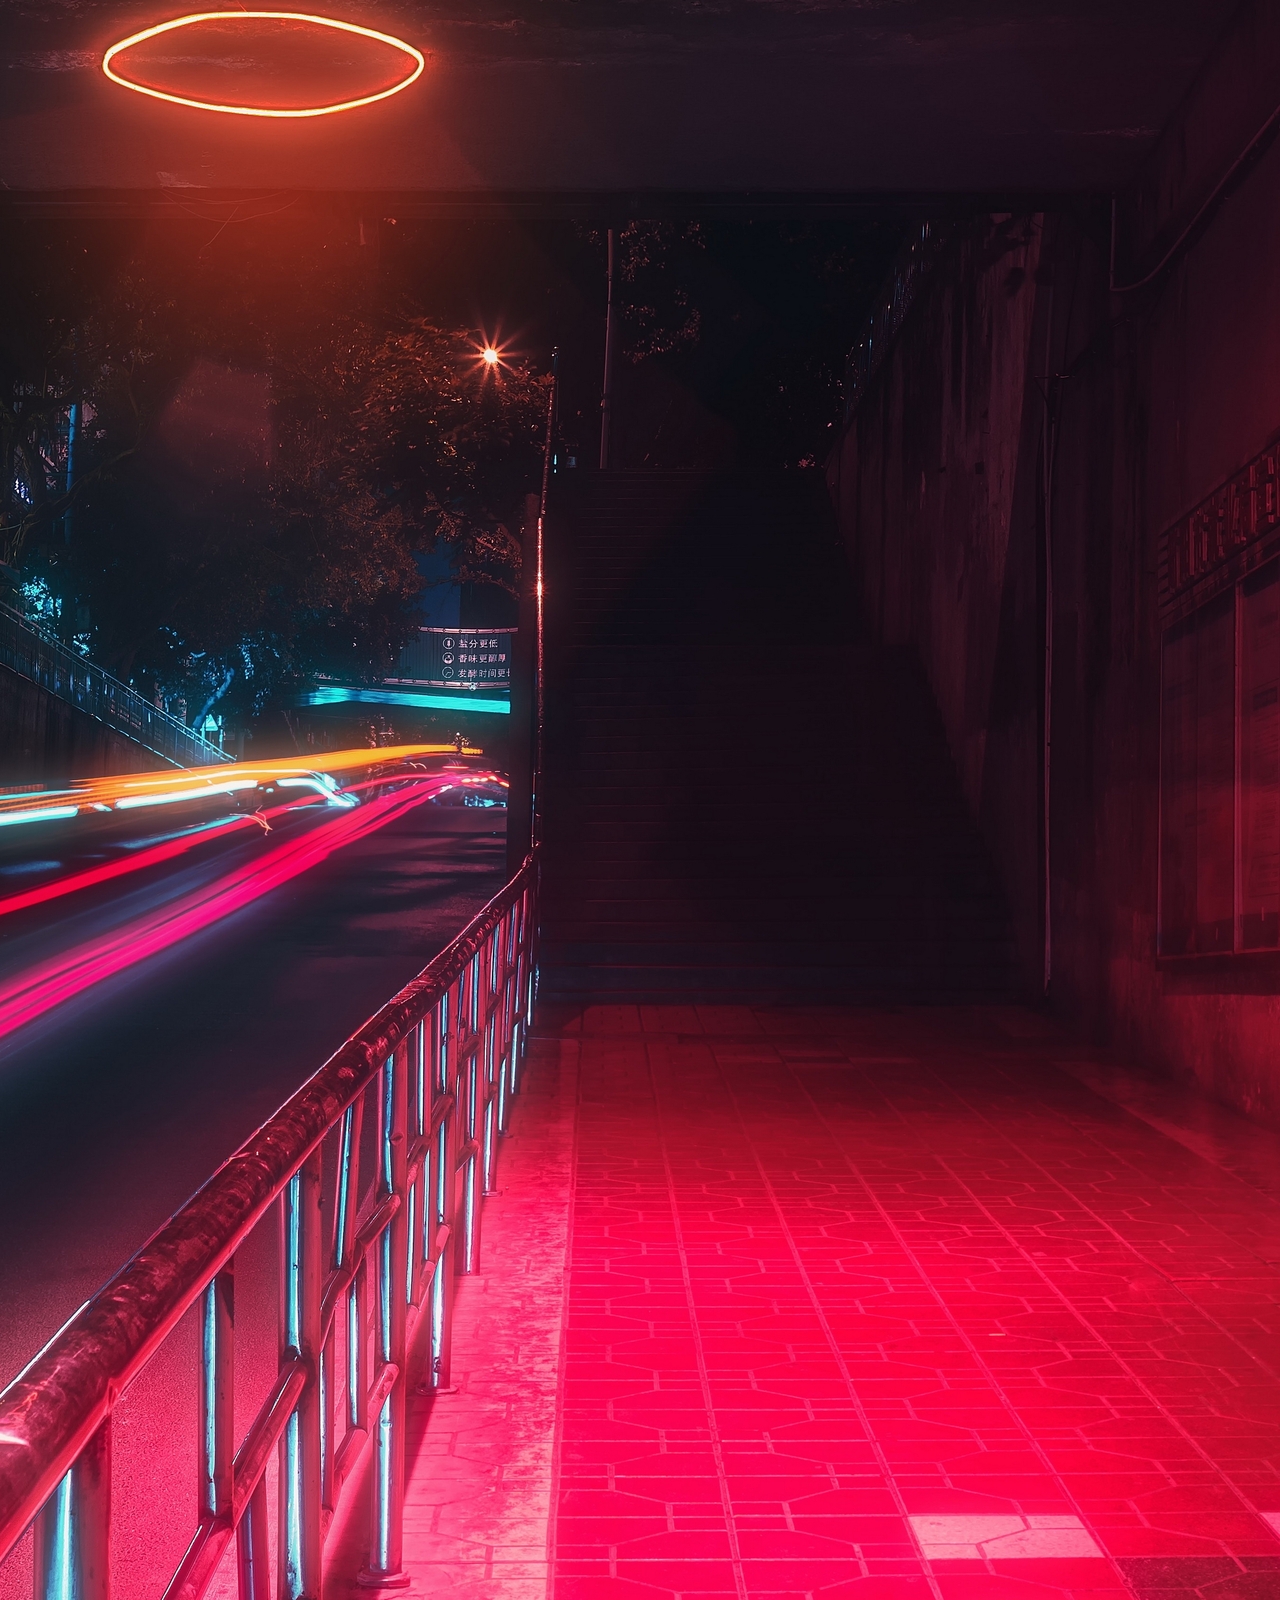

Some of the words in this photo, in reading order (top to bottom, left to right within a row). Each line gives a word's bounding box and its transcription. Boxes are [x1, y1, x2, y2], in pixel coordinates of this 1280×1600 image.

[458, 639, 498, 648] 盐分更低
[458, 654, 506, 663] 香味更醇厚
